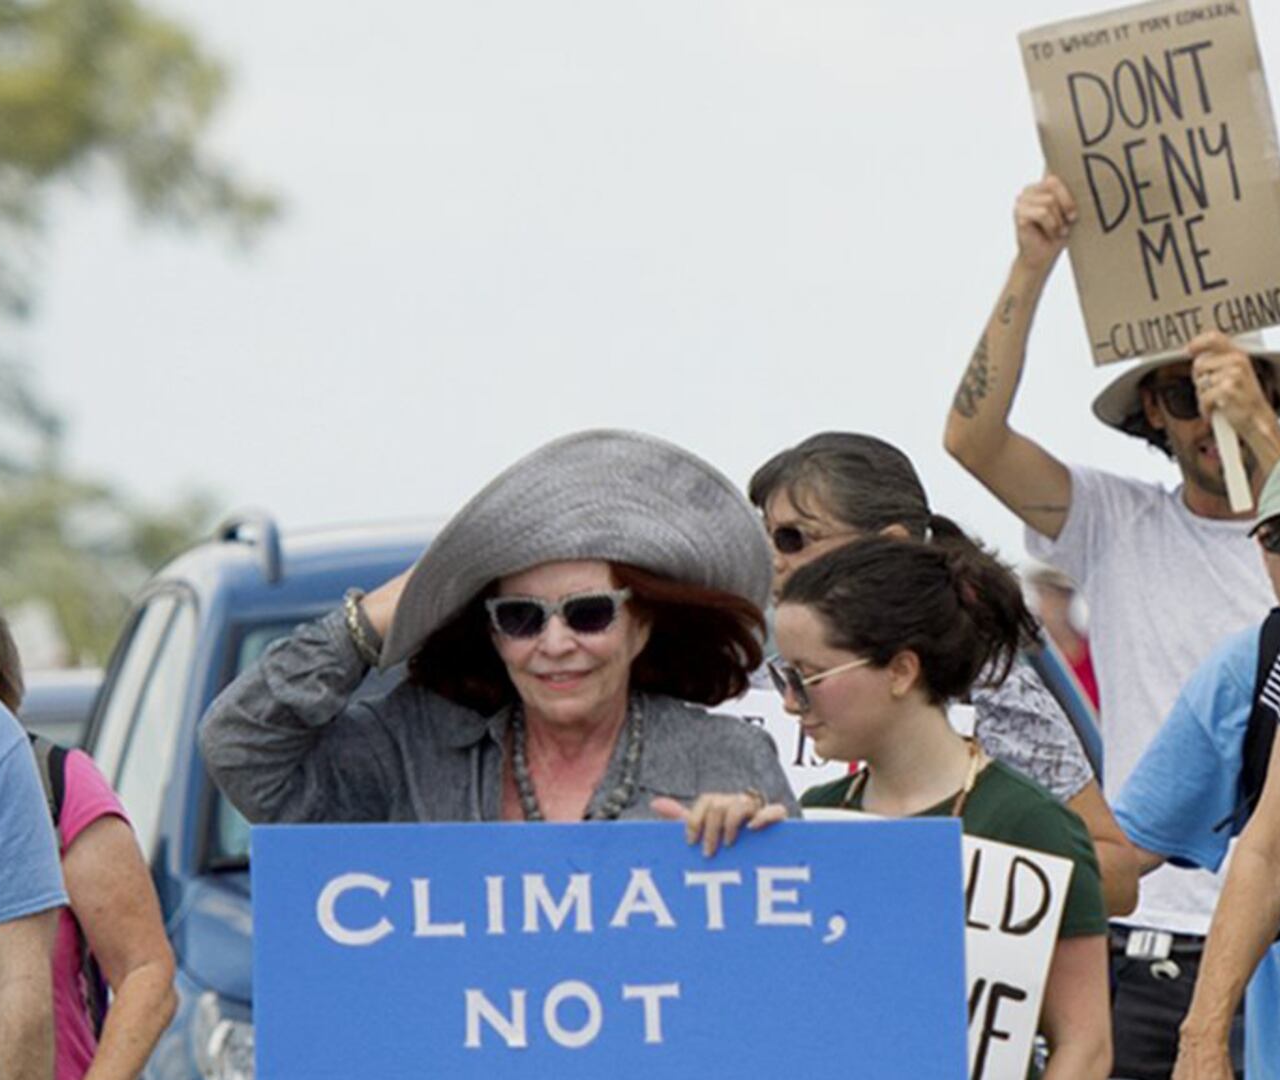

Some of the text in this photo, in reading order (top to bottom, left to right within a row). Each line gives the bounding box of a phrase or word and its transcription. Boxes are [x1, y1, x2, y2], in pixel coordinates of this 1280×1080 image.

[1028, 42, 1054, 61] TO
[1060, 29, 1110, 52] WHOM
[1114, 23, 1131, 41] IT
[1139, 15, 1171, 34] MAY
[1067, 40, 1213, 147] DONT
[1082, 122, 1241, 234] DENY
[1137, 214, 1229, 301] ME
[315, 865, 848, 946] CLIMATE,
[463, 979, 681, 1049] NOT
